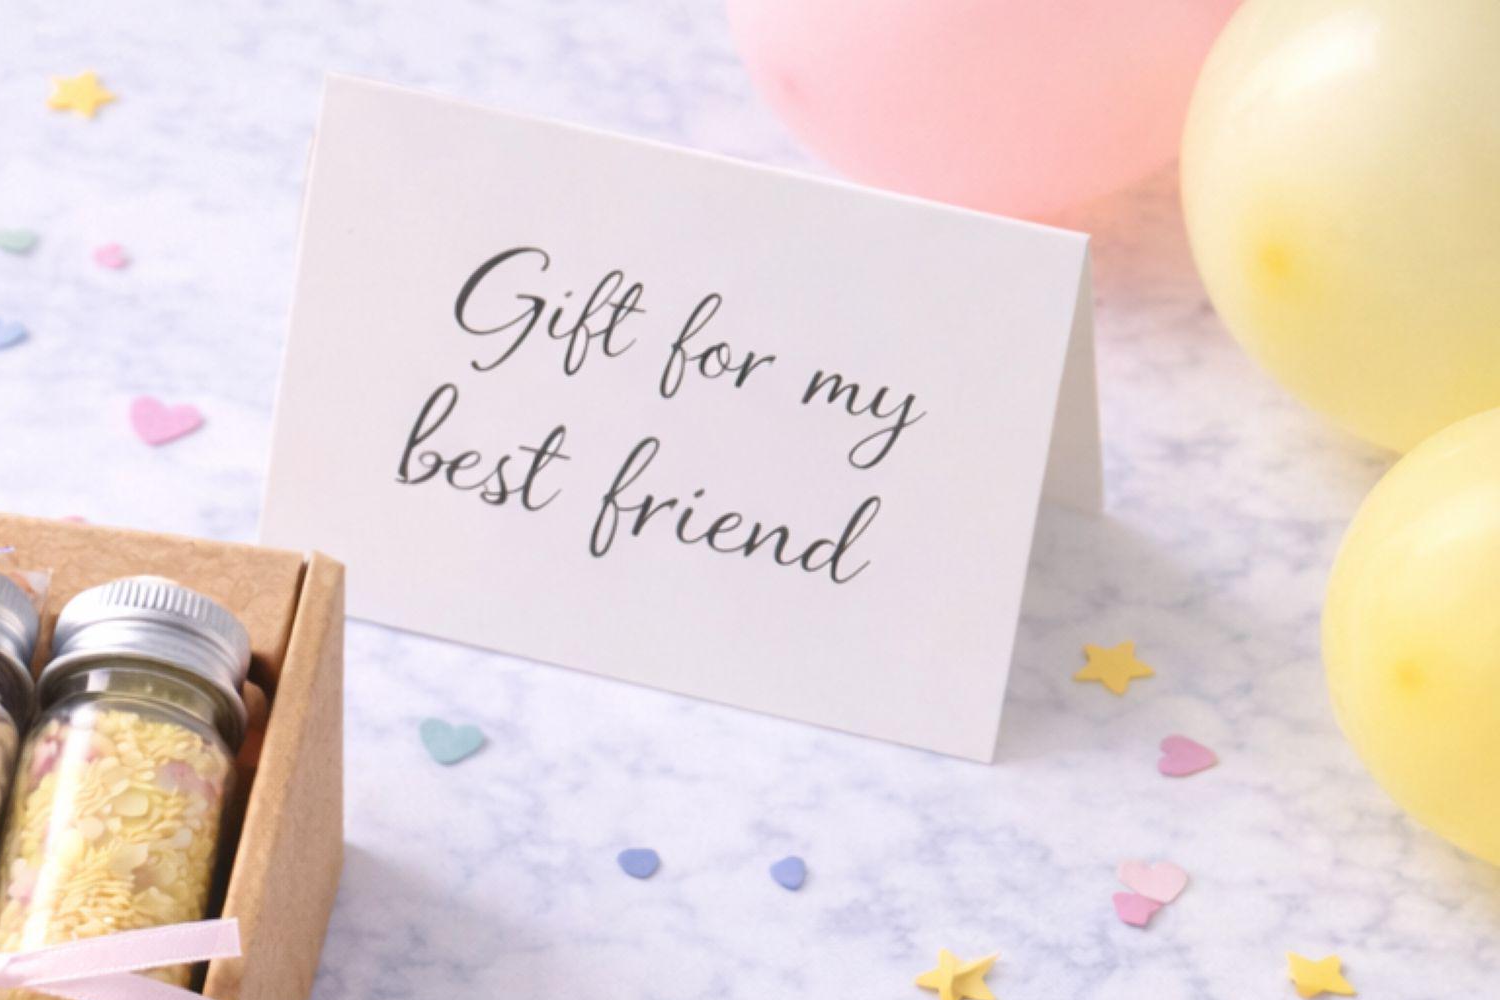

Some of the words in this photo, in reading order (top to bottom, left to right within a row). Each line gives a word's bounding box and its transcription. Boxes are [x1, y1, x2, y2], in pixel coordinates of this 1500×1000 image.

[454, 246, 646, 377] Gift
[659, 293, 776, 399] for
[801, 370, 927, 470] my
[395, 383, 571, 511] best
[589, 437, 882, 584] friend
